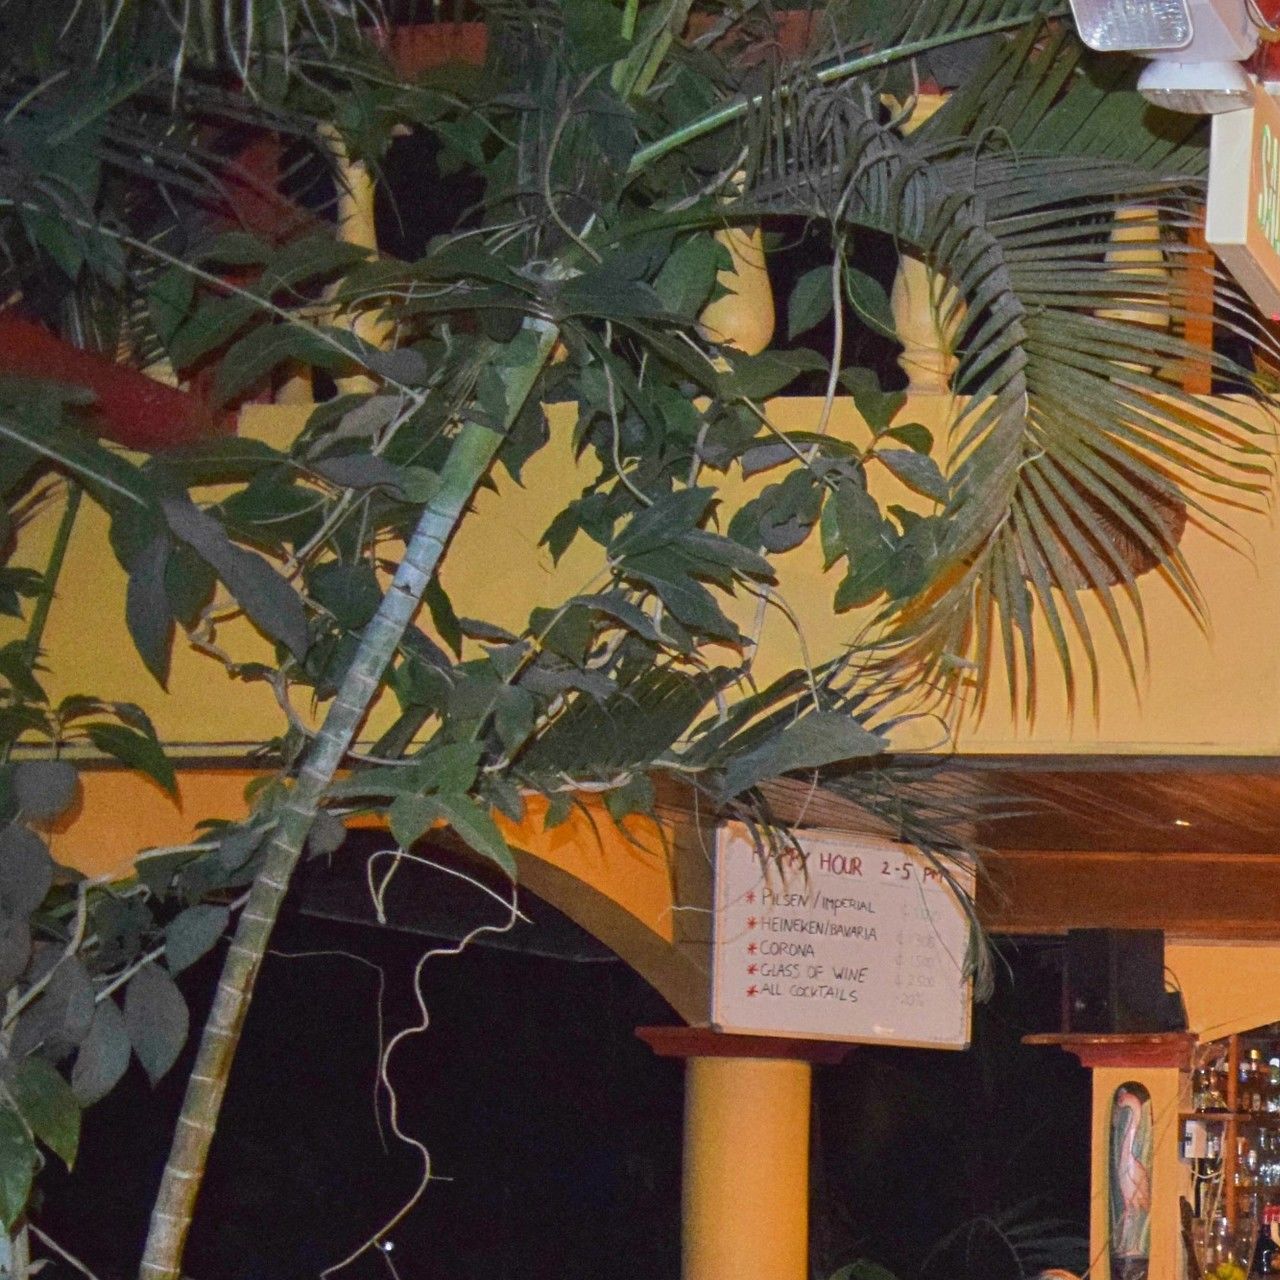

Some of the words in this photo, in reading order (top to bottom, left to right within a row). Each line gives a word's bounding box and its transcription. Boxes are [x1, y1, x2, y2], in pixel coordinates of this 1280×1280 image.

[820, 852, 863, 876] HOUR
[880, 861, 913, 880] 2-5
[759, 940, 815, 957] CORONA
[759, 963, 800, 979] GLASS
[807, 965, 824, 980] OF
[832, 967, 868, 984] WINE
[761, 982, 782, 996] ALL
[790, 984, 859, 1003] COCKTAILS
